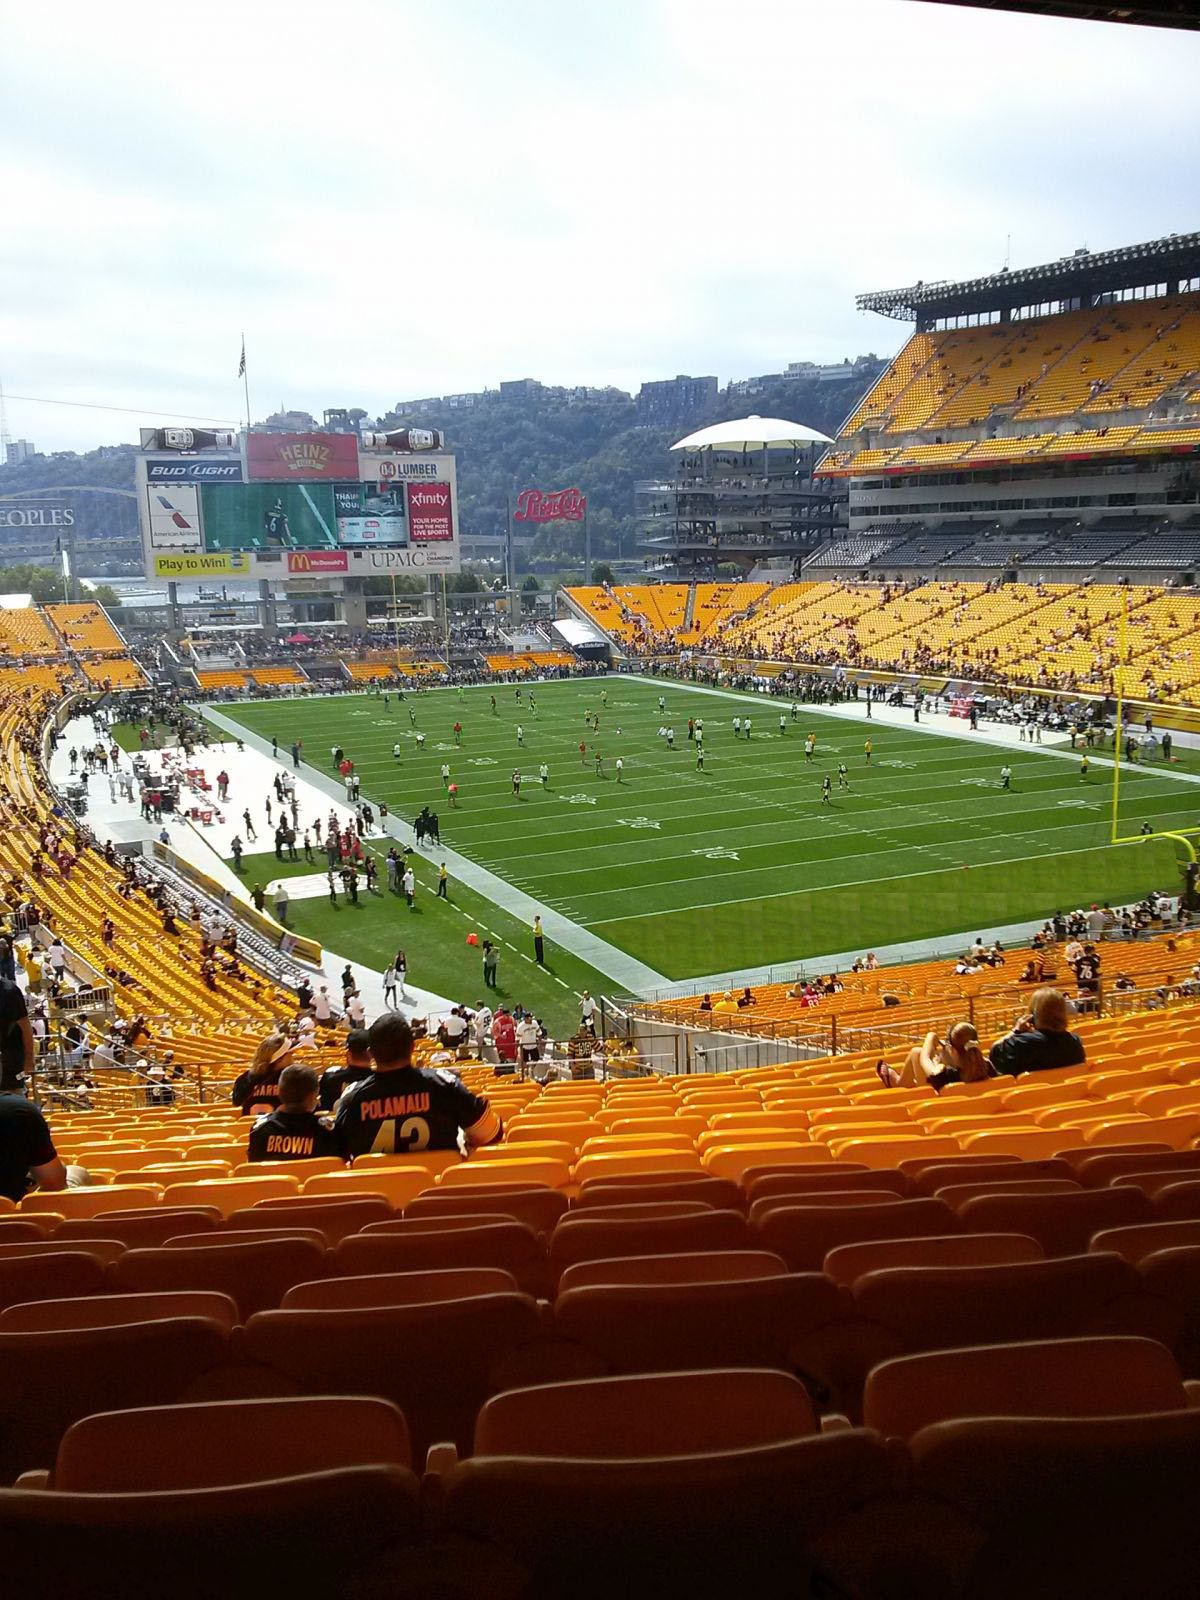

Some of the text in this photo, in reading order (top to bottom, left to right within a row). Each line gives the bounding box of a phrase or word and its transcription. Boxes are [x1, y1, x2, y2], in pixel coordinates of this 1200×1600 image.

[280, 444, 330, 461] HEINZ
[150, 466, 239, 475] BUD LIGHT
[398, 464, 438, 475] LUMBER
[411, 492, 448, 507] xfinity
[159, 559, 184, 572] Play
[186, 559, 198, 569] to
[200, 558, 226, 568] Win!
[371, 552, 424, 568] UPMC
[691, 846, 740, 861] 10
[1079, 964, 1093, 980] 76
[361, 1092, 430, 1121] POLAMALU
[267, 1135, 314, 1155] BROWN
